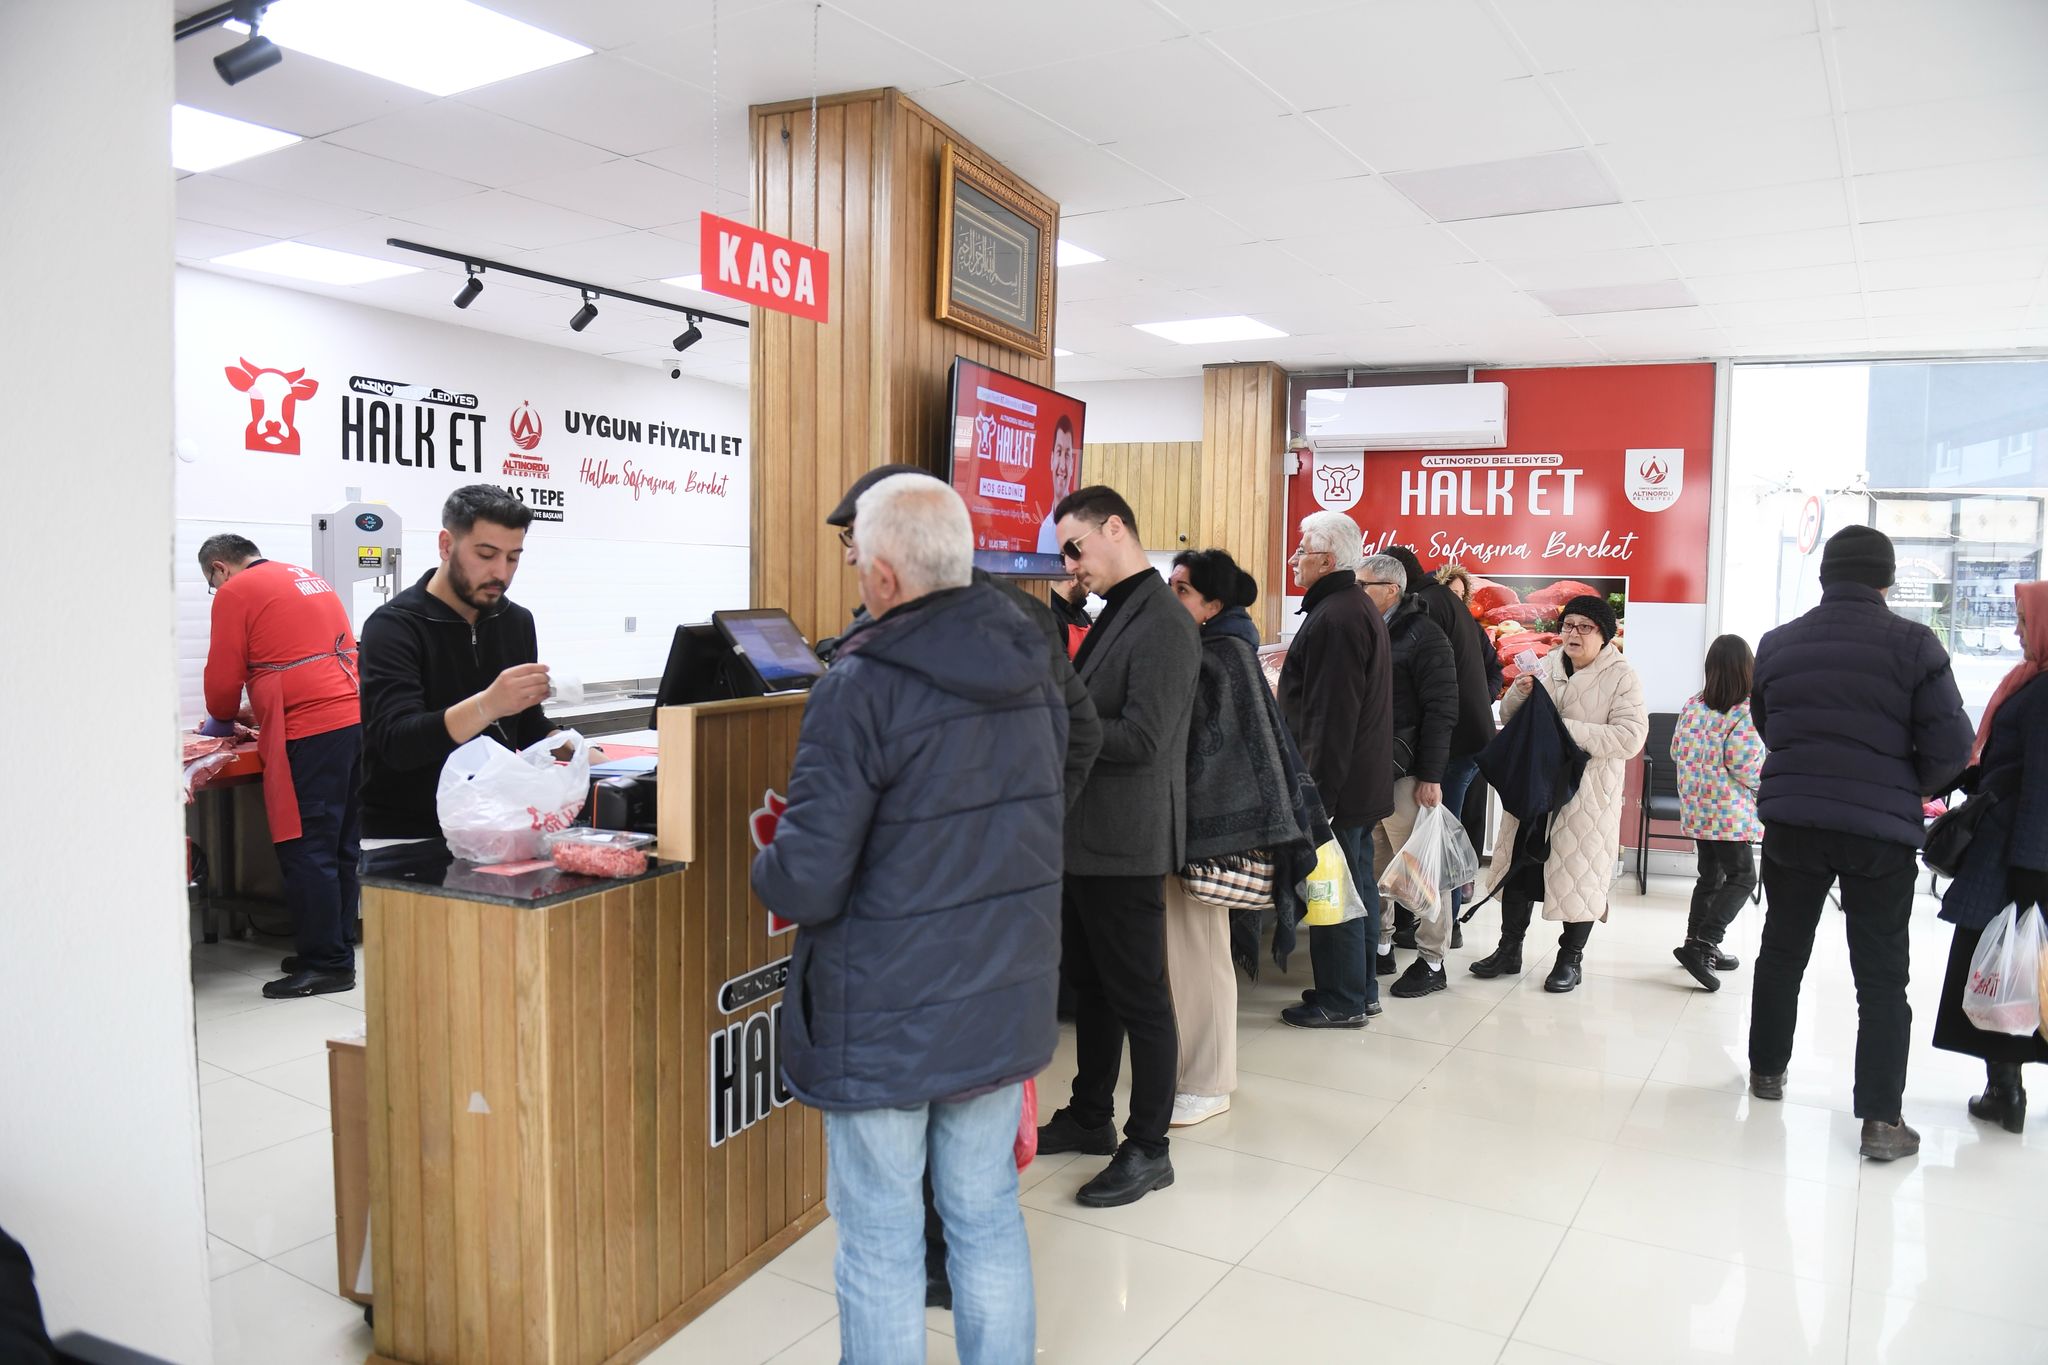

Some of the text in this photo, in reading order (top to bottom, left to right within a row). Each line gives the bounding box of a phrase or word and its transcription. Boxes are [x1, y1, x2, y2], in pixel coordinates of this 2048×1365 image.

[719, 230, 815, 306] KASA
[353, 379, 397, 395] ALTINO
[342, 395, 487, 473] HALK ET
[565, 410, 742, 457] UYGUN FİYATLI ET
[996, 424, 1036, 469] HALK ET
[503, 460, 550, 472] ALTINORDU
[503, 469, 550, 479] BELEDİYESİ
[580, 457, 729, 501] Halkın Sofrasına Bereket
[1426, 456, 1559, 465] ALTINORDU BELEDİYESİ
[531, 488, 564, 507] TEPE
[982, 482, 995, 495] HOŞ
[1400, 468, 1583, 516] HALK ET
[1427, 530, 1531, 566] Sofrasına
[1541, 530, 1639, 561] Bereket
[711, 1002, 794, 1147] HAL
